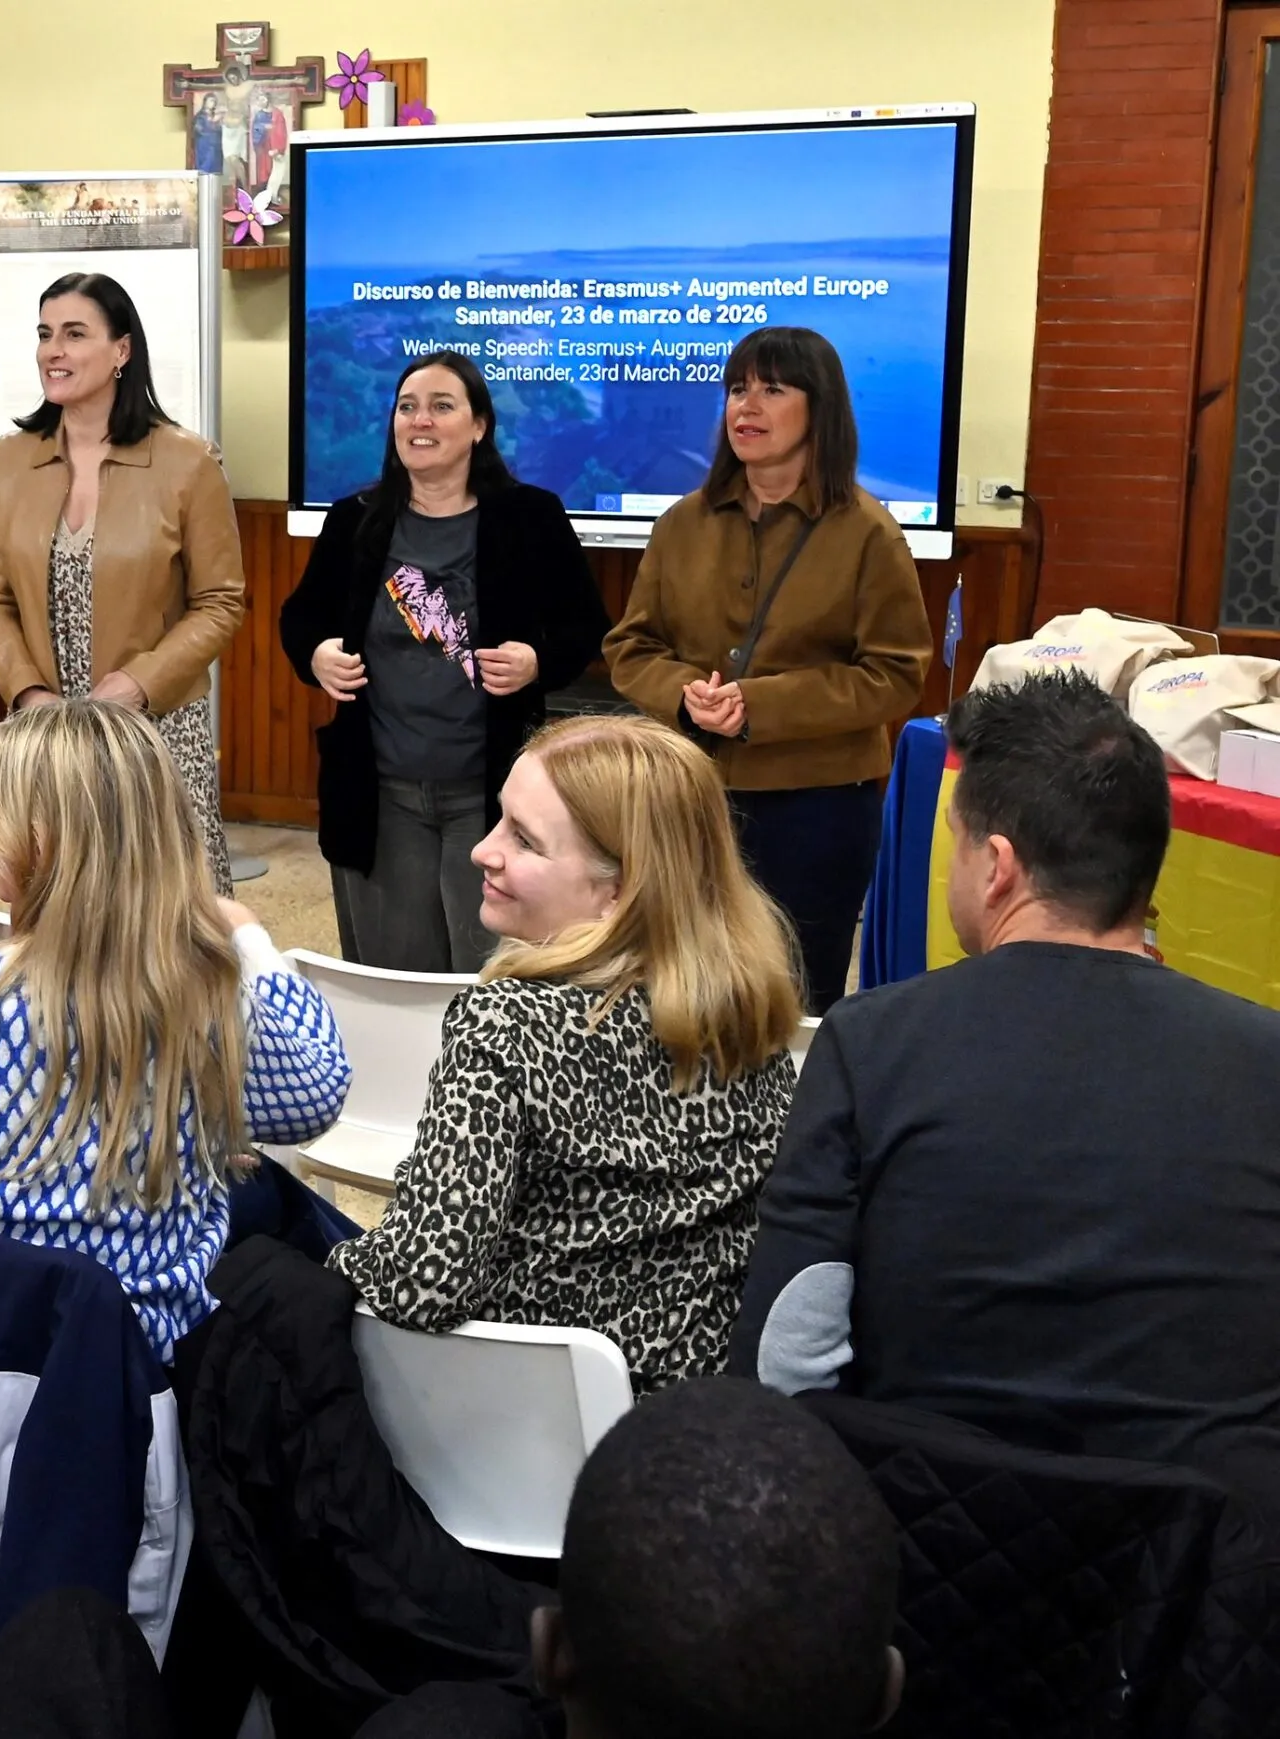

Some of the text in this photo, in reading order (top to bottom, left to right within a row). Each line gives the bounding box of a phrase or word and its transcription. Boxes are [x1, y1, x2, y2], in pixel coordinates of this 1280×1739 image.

[40, 216, 144, 226] THE EUROPEAN UNION
[62, 208, 131, 218] FUNDAMENTAL
[169, 207, 182, 216] OF
[352, 276, 889, 301] Discurso de Bienvenida: Erasmus+ Augmented Europe
[455, 304, 768, 327] Santander, 23 de marzo de 2026
[402, 338, 734, 361] Welcome Speech: Erasmus+ Augment
[484, 363, 574, 383] Santander,
[579, 363, 619, 381] 23rd
[624, 363, 680, 382] March
